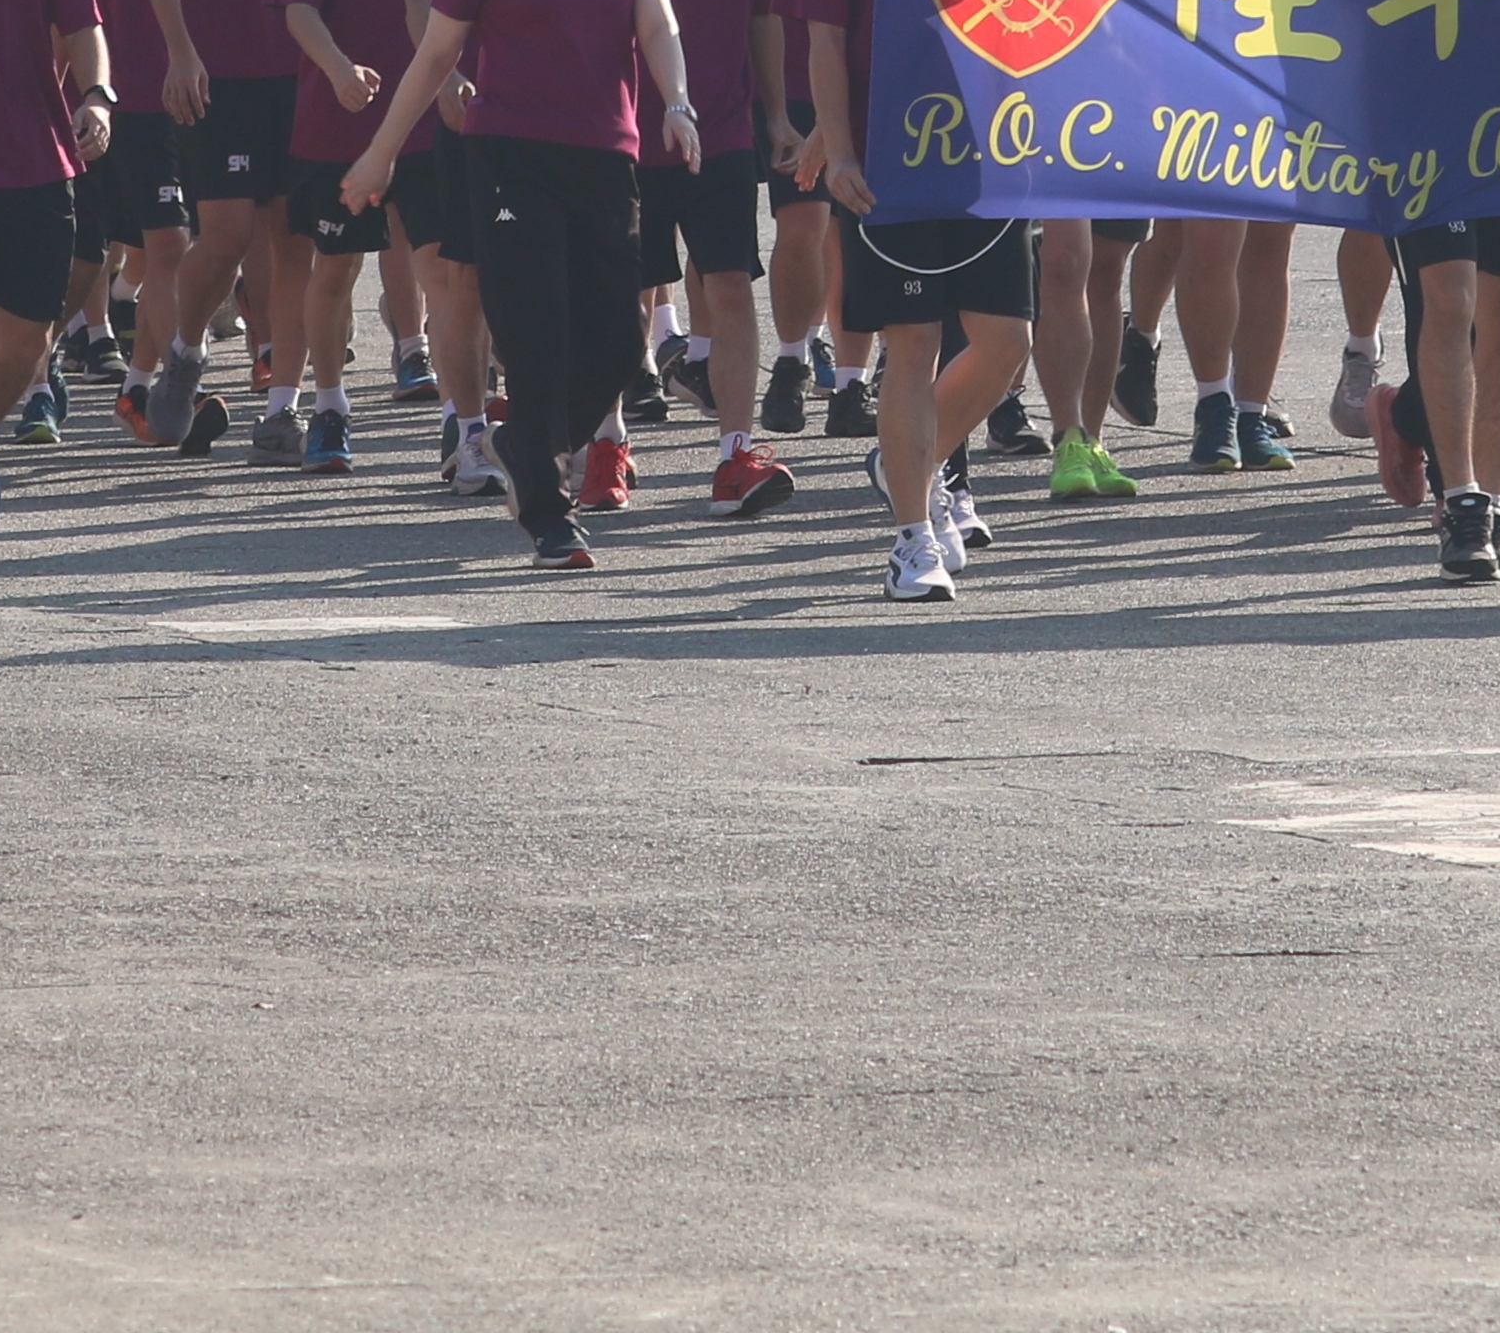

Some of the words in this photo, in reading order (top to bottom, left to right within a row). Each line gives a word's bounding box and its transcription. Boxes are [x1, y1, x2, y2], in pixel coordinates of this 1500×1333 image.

[227, 155, 249, 172] 94
[903, 91, 1124, 171] R.O.C.
[1152, 106, 1444, 219] Military
[158, 186, 183, 203] 94
[318, 219, 345, 237] 94
[1448, 220, 1467, 233] 93
[904, 280, 922, 295] 93
